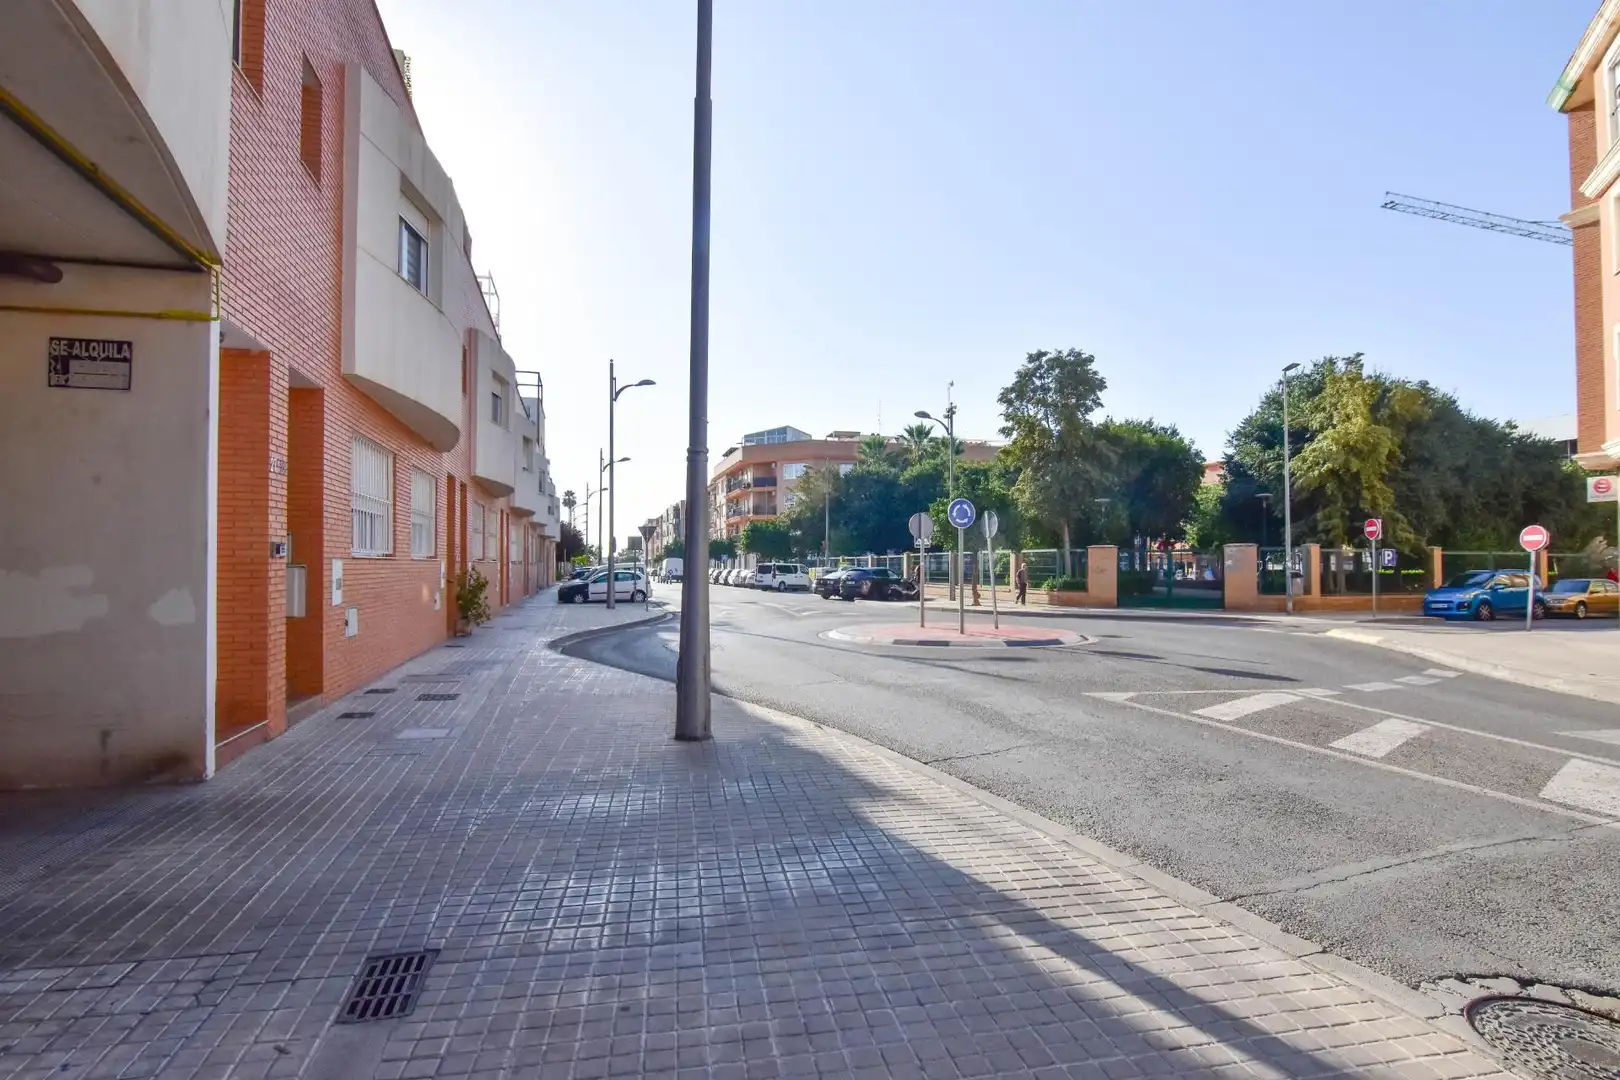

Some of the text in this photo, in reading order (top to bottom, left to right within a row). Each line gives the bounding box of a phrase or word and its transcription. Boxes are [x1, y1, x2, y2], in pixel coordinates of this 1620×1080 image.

[51, 340, 131, 358] SE ALQUILA
[1384, 550, 1392, 564] P
